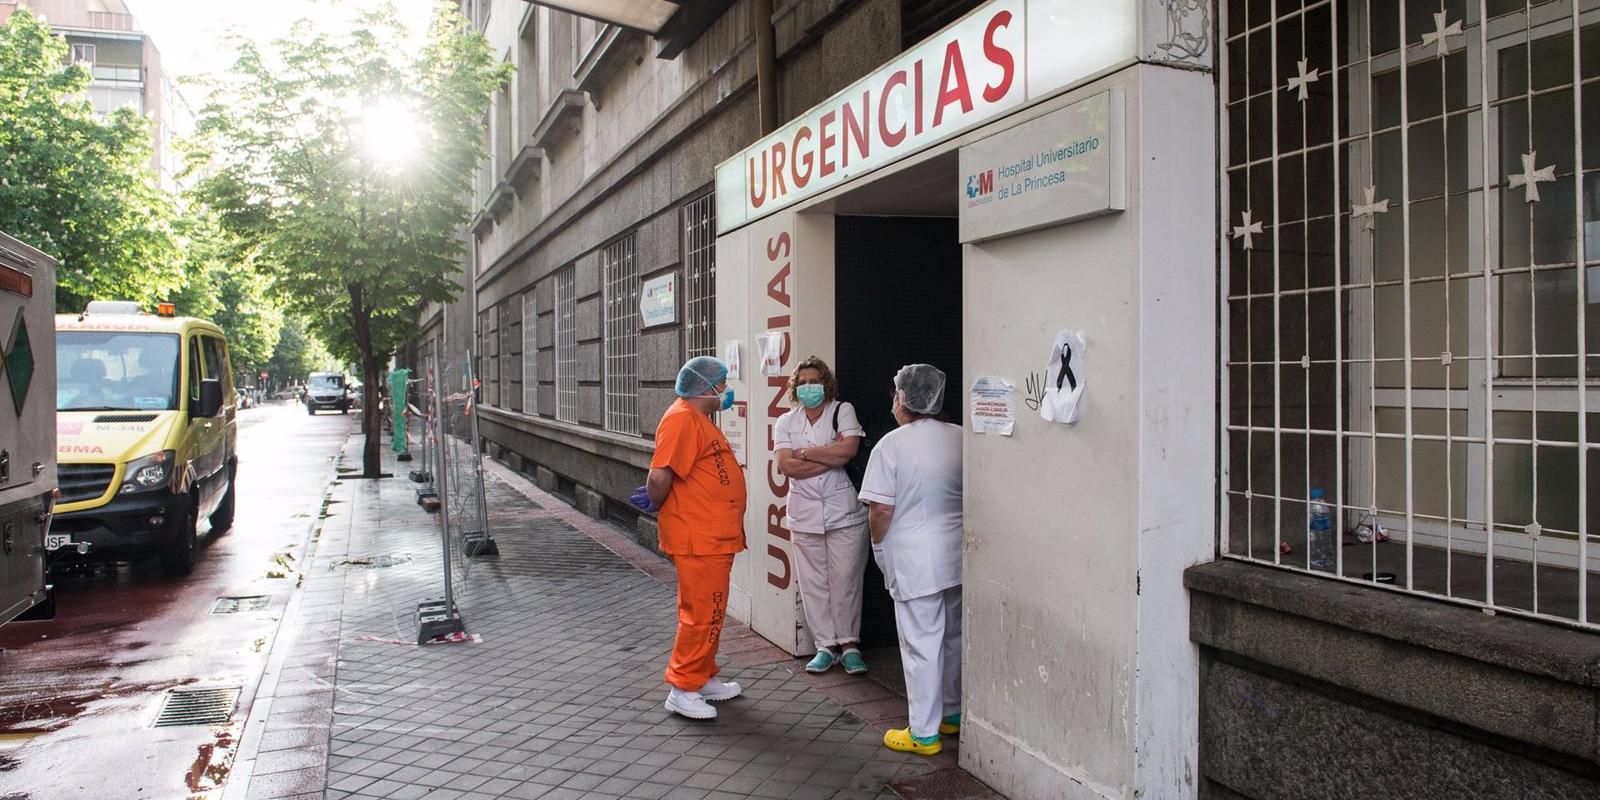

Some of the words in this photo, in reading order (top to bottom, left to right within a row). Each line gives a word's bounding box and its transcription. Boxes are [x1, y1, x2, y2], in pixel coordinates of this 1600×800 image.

[750, 10, 1014, 208] URGENCIAS
[998, 154, 1034, 179] Hospital
[1036, 137, 1099, 168] Universitario
[998, 187, 1009, 200] de
[1011, 184, 1022, 197] La
[1024, 170, 1066, 192] Princesa
[767, 231, 791, 590] URGNIAS
